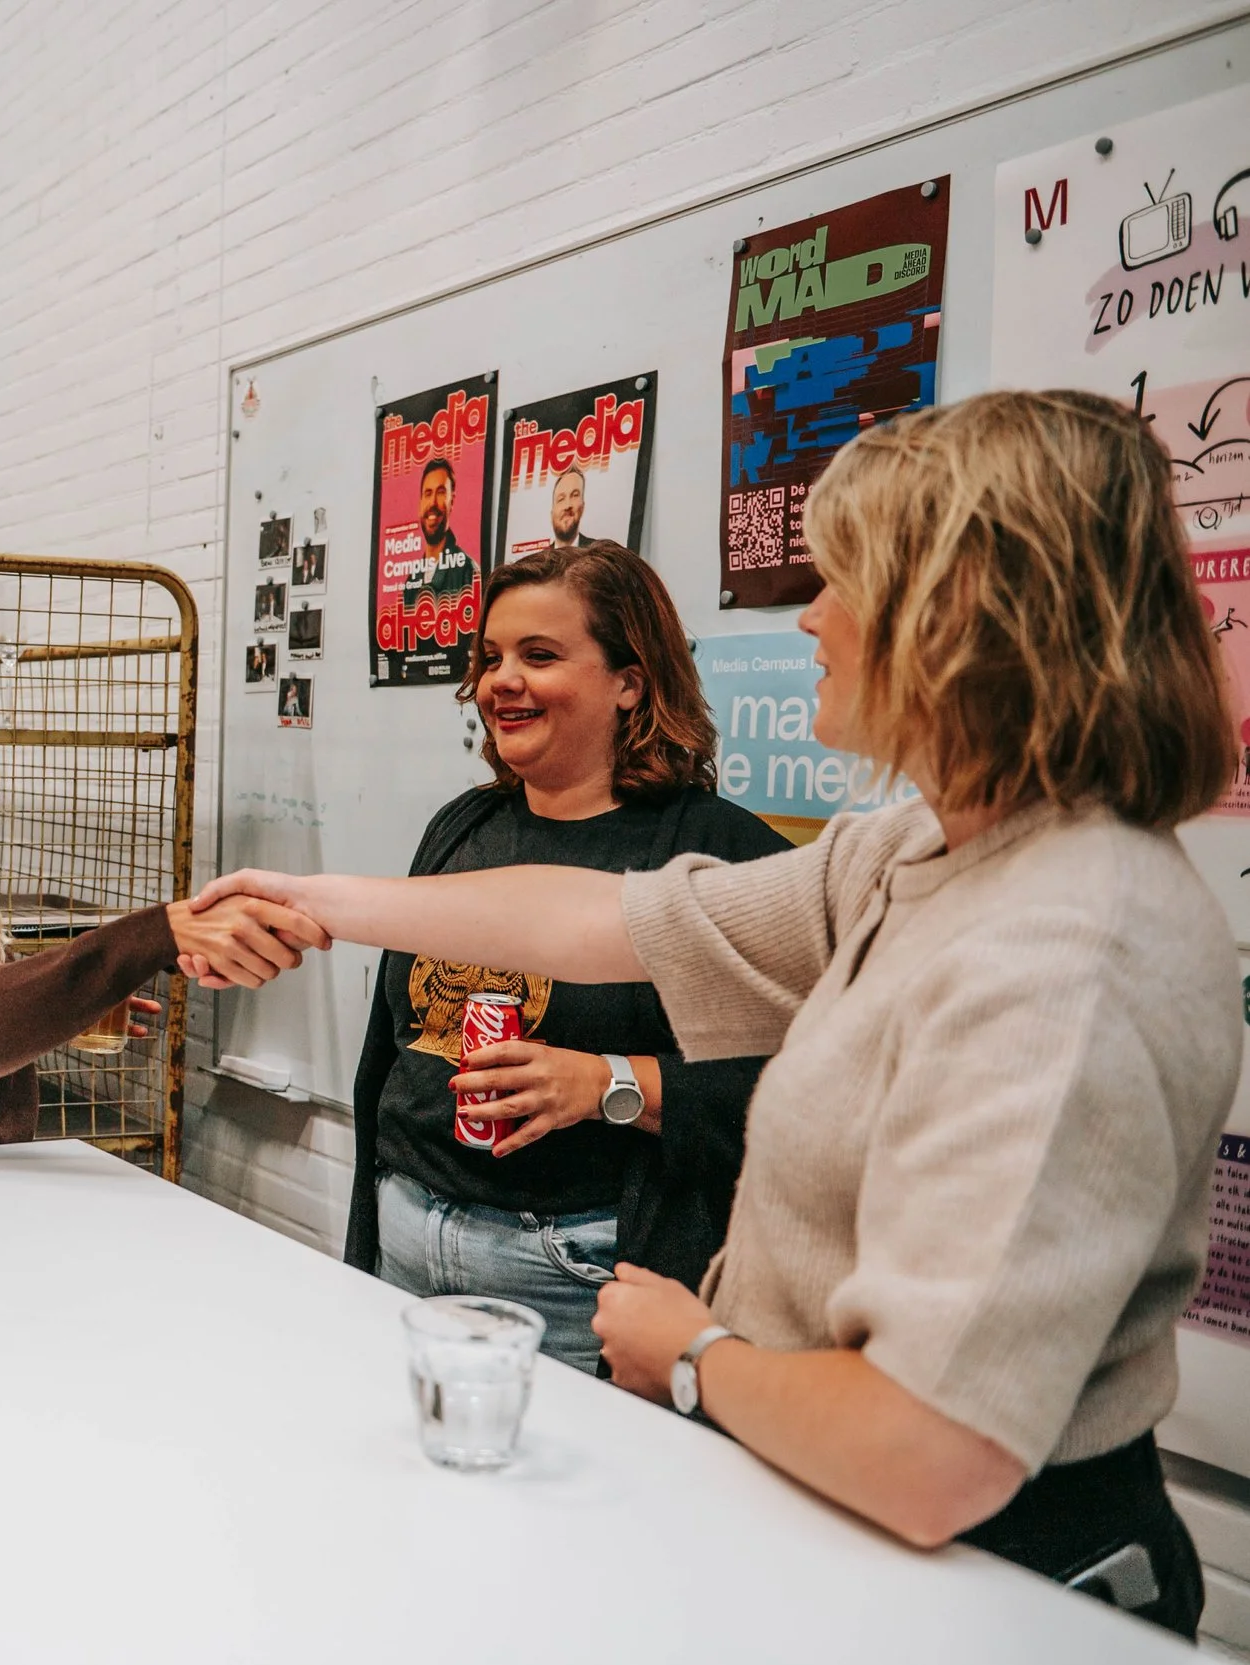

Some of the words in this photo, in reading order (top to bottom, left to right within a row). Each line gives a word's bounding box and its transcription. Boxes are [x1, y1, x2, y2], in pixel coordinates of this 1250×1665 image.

[902, 257, 927, 271] AHEAD
[904, 247, 928, 261] MEDIA
[894, 265, 927, 281] DISCORD
[1093, 288, 1134, 336] ZO
[1149, 263, 1224, 319] DOEN
[381, 389, 489, 472] media
[511, 392, 644, 481] media
[514, 417, 539, 438] the
[1208, 451, 1245, 465] horizon
[384, 531, 422, 557] Media
[383, 555, 437, 580] Campus
[437, 547, 467, 571] Live
[712, 657, 748, 674] Media
[751, 655, 806, 674] Campus
